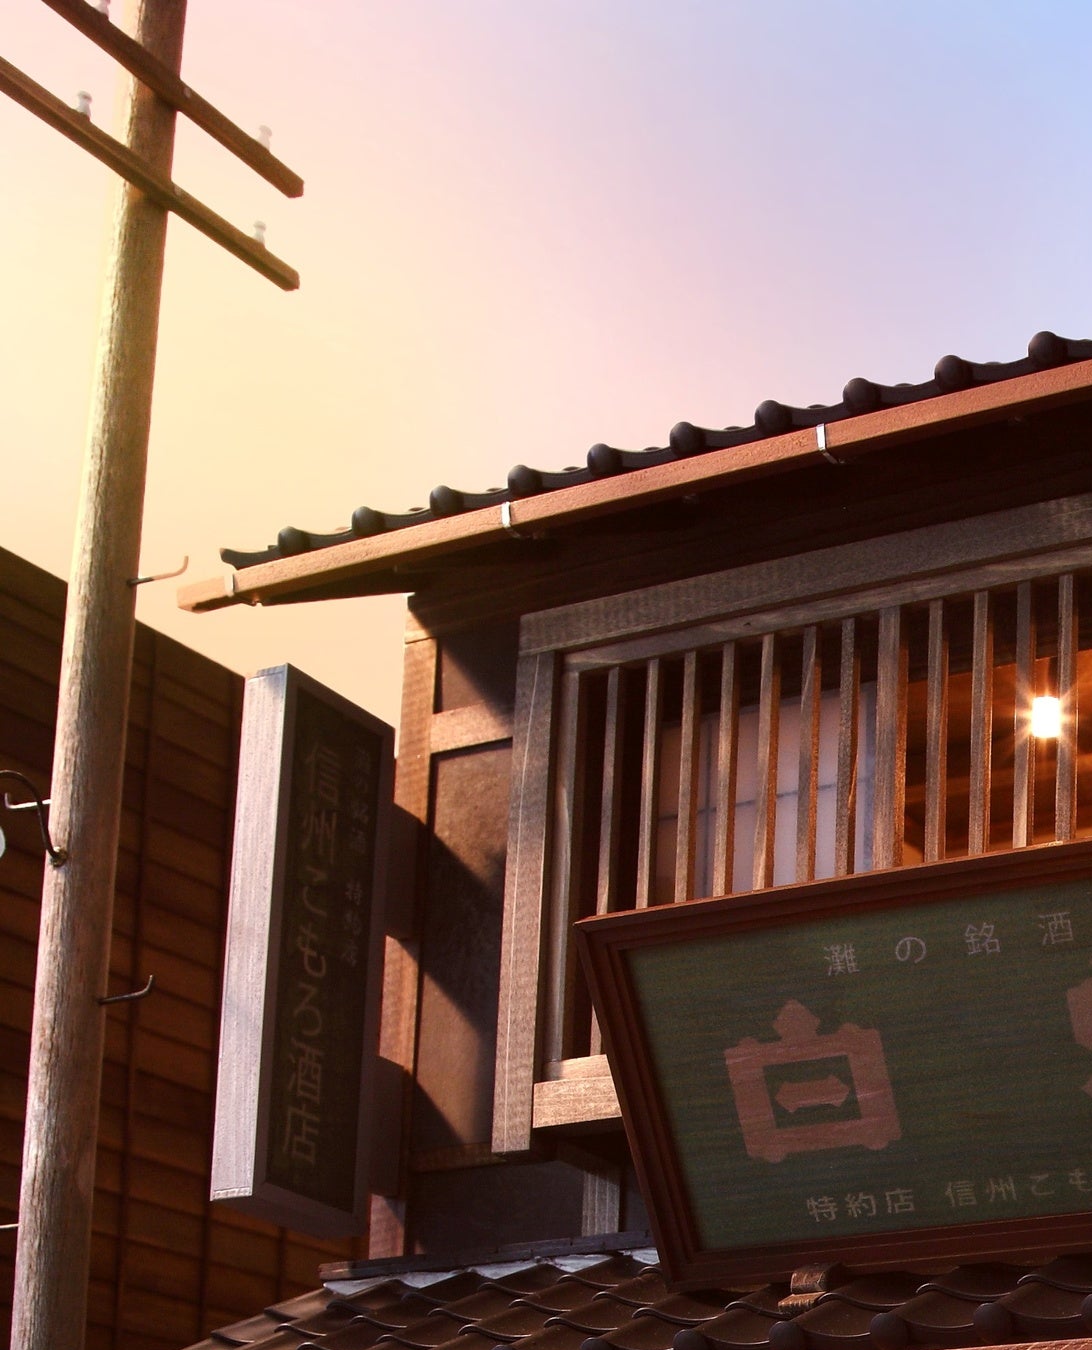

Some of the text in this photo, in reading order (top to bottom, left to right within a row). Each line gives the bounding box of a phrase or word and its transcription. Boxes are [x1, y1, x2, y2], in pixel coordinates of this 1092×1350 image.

[282, 744, 342, 1163] 信州こもろ酒店
[823, 912, 1073, 975] 灘の銘酒
[806, 1188, 916, 1222] 特約店
